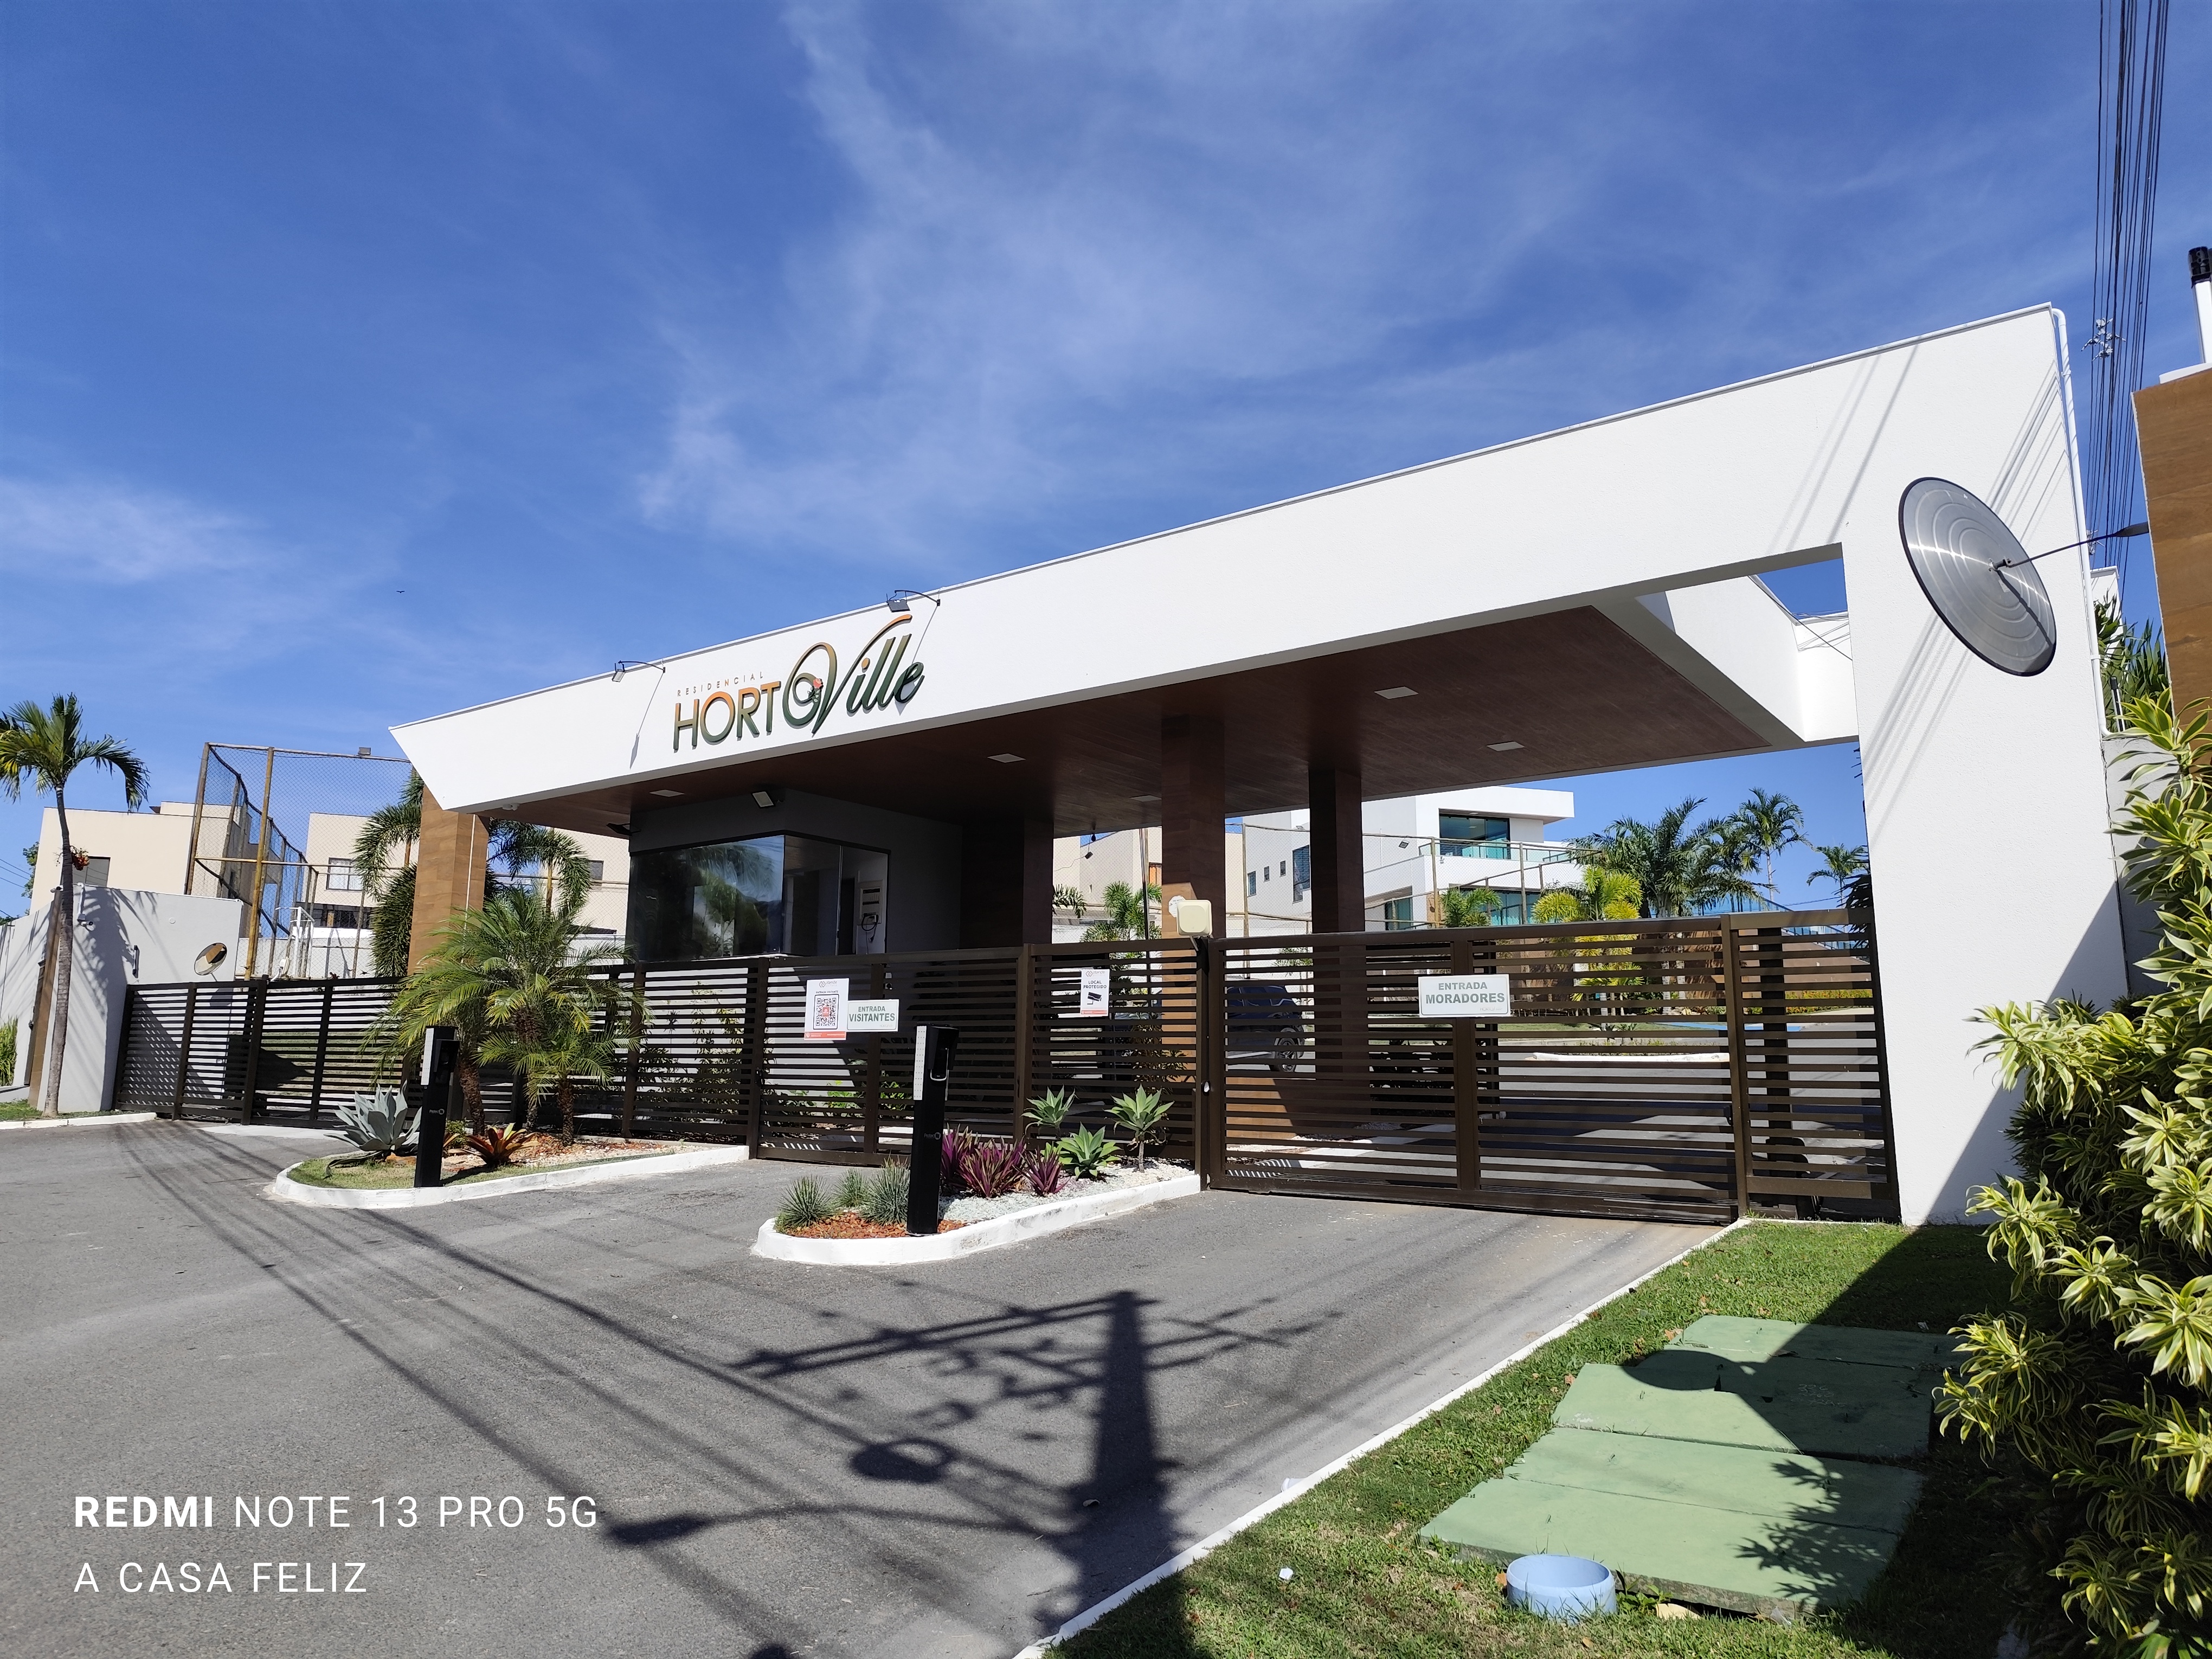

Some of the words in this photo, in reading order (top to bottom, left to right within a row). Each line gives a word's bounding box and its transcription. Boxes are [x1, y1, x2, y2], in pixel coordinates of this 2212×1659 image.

[677, 671, 763, 697] RESIDENCIAL
[1438, 982, 1488, 991] ENTRADA
[1425, 993, 1505, 1004] MORADORES
[849, 1013, 895, 1022] VISITANTES
